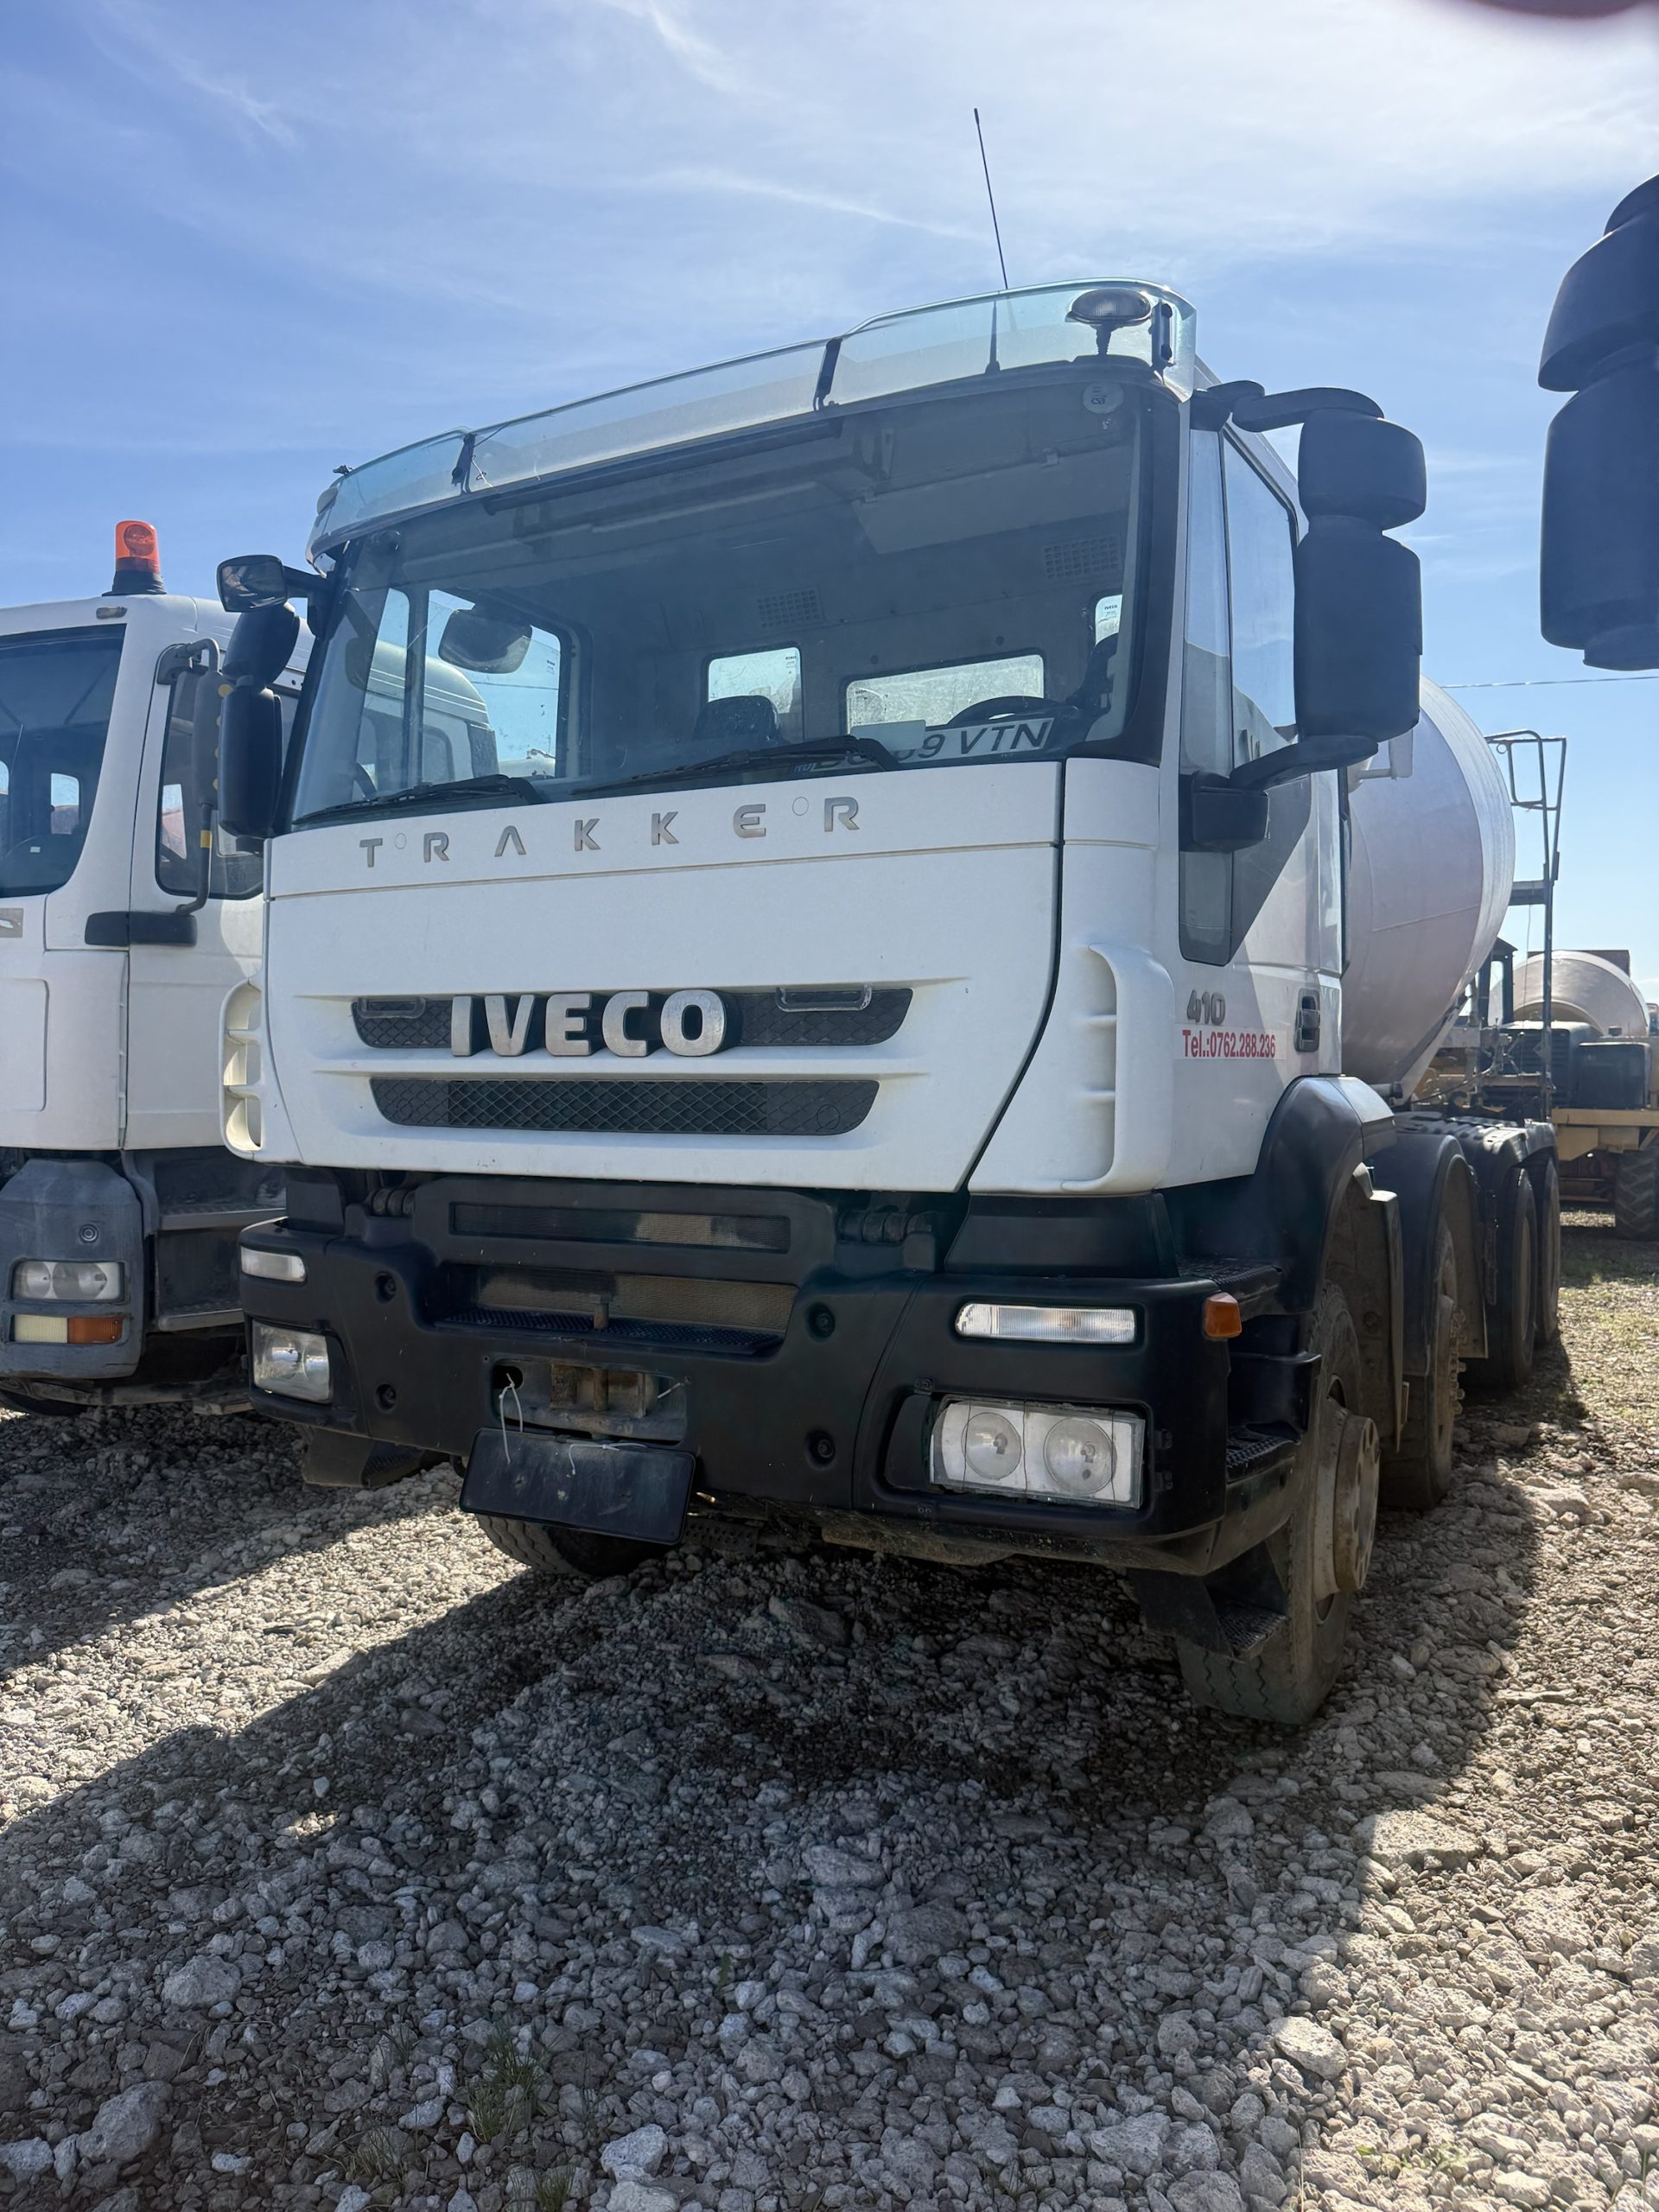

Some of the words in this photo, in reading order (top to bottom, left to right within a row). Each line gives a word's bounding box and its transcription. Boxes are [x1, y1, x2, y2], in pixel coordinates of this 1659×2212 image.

[960, 723, 1051, 755] VTN
[359, 796, 860, 868] TRAKKER
[451, 988, 728, 1058] IVECO
[1186, 989, 1226, 1026] 410
[1182, 1029, 1276, 1058] Tel.:0762.288.236
